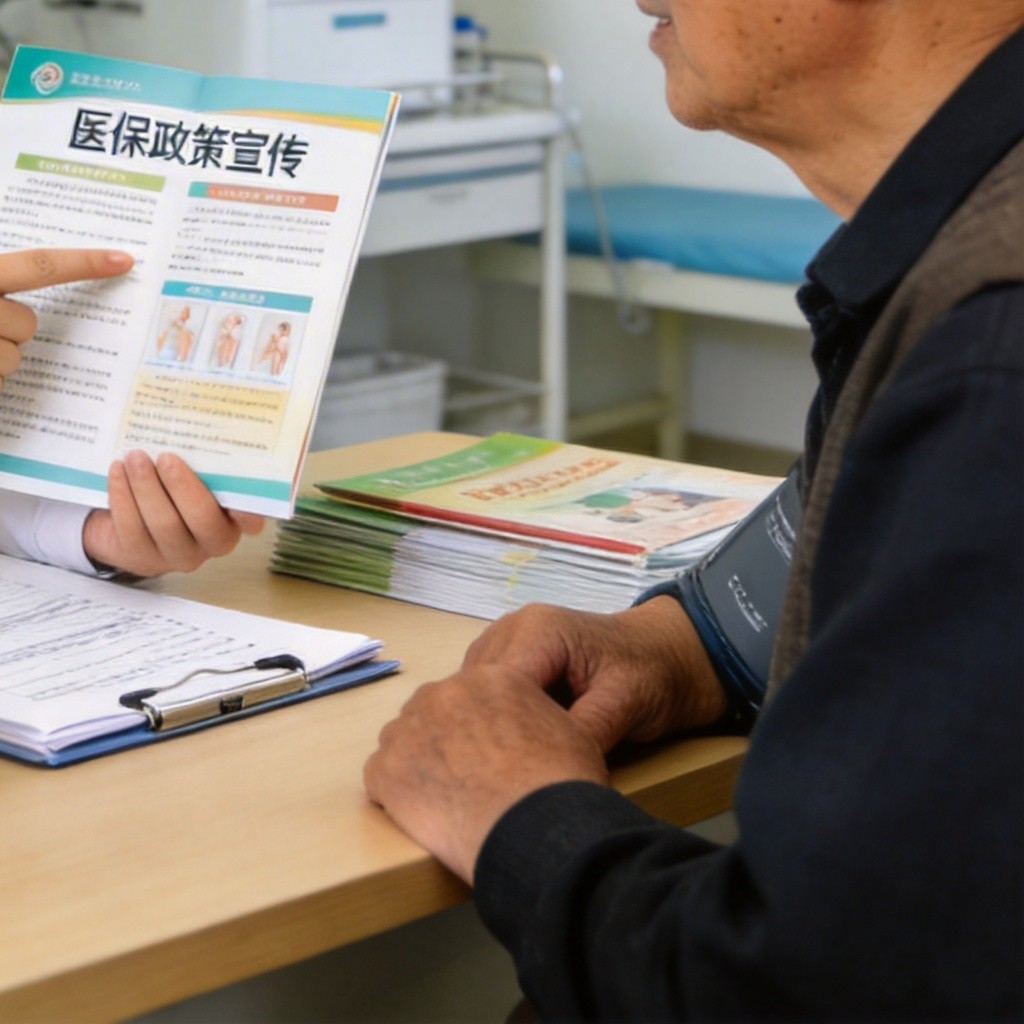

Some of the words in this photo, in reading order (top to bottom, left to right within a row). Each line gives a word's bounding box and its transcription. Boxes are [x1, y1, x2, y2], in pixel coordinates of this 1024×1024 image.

[69, 109, 308, 177] 医保政策宣传
